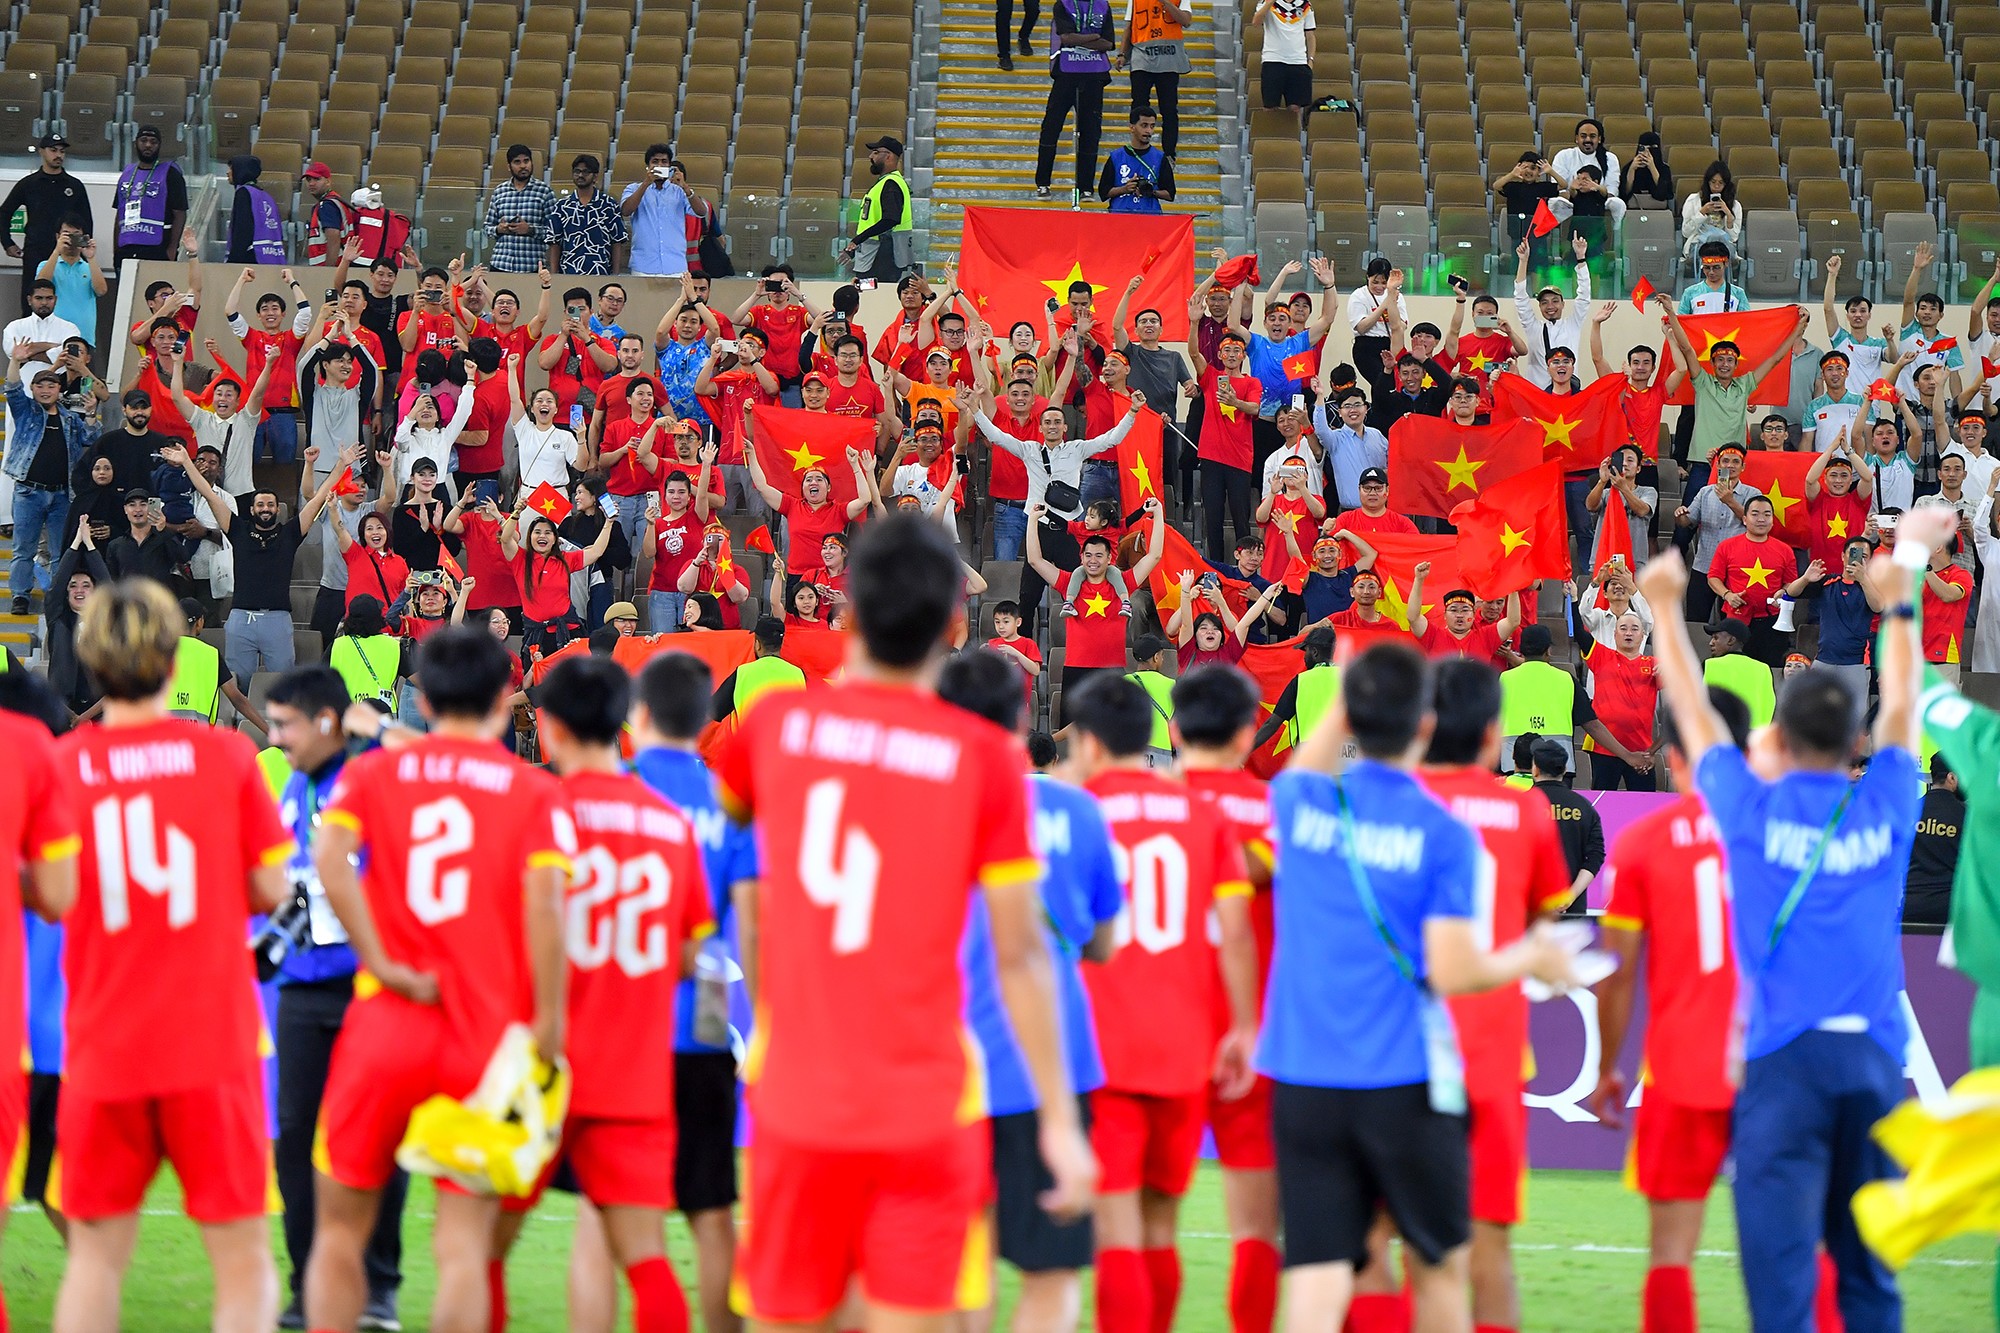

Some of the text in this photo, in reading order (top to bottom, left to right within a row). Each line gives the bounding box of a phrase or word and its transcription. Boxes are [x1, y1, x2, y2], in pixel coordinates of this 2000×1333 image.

[1151, 28, 1162, 38] 299
[1145, 45, 1176, 56] STEWARD
[426, 332, 437, 345] 19
[176, 692, 190, 705] 160
[1529, 716, 1545, 729] 1654
[1550, 804, 1582, 821] lice
[1915, 818, 1957, 838] olice
[1765, 817, 1892, 877] VIENAM
[93, 793, 197, 934] 14
[407, 795, 474, 927] 2
[799, 778, 882, 955] 4
[566, 844, 672, 978] 22
